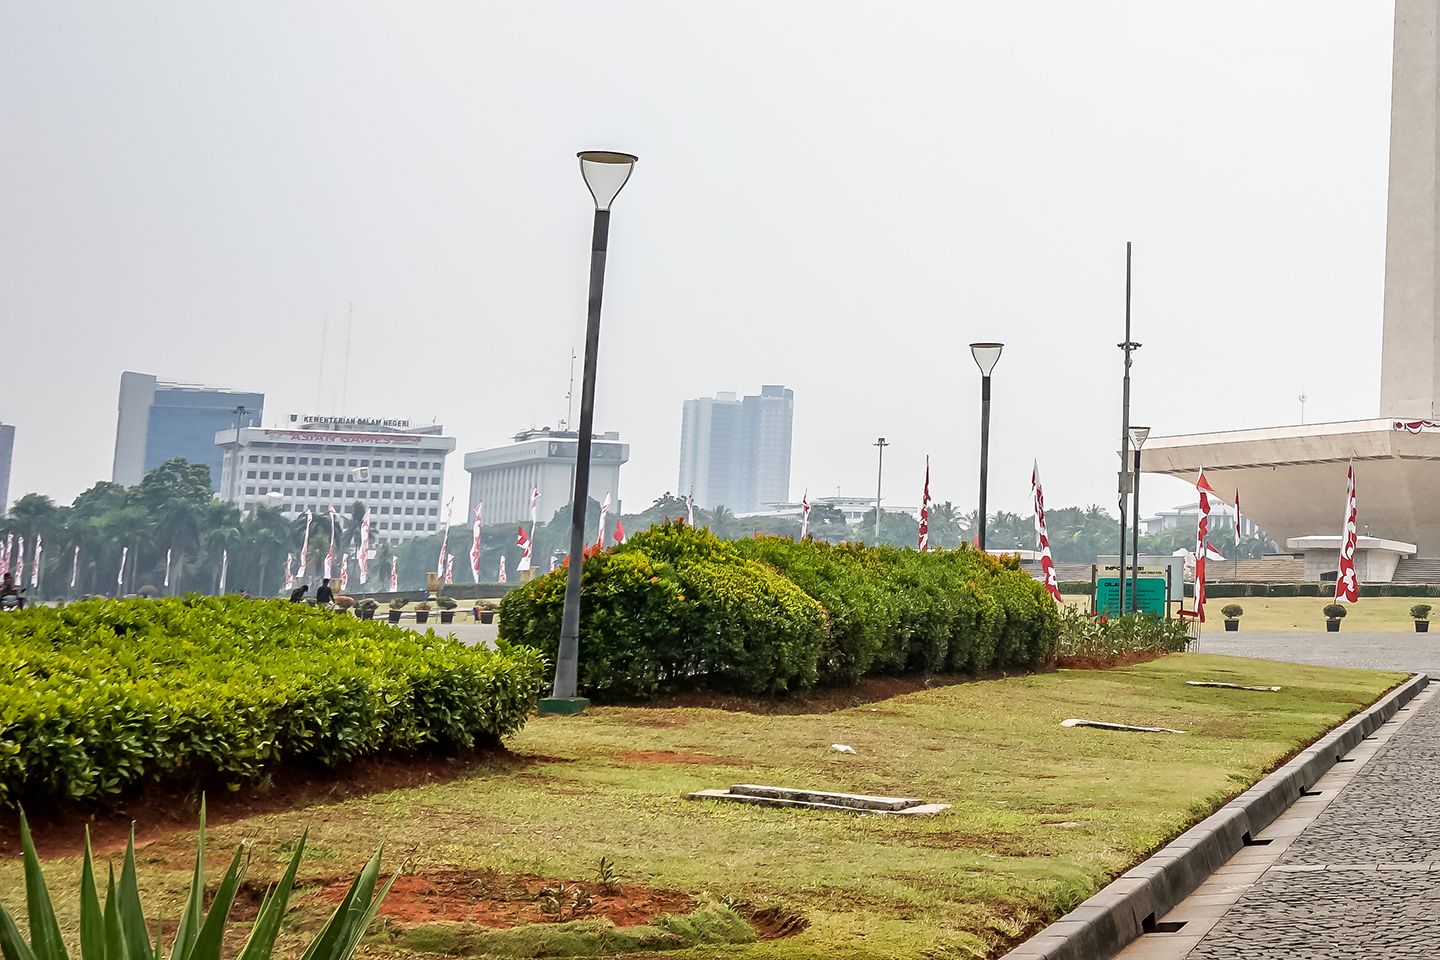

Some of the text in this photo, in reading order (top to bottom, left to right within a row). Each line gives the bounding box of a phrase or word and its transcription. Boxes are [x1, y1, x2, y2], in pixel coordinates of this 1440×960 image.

[303, 416, 410, 427] KEMENTERIAN DALAM NEGERI
[290, 433, 337, 443] ASIAN
[339, 434, 393, 445] GAMES
